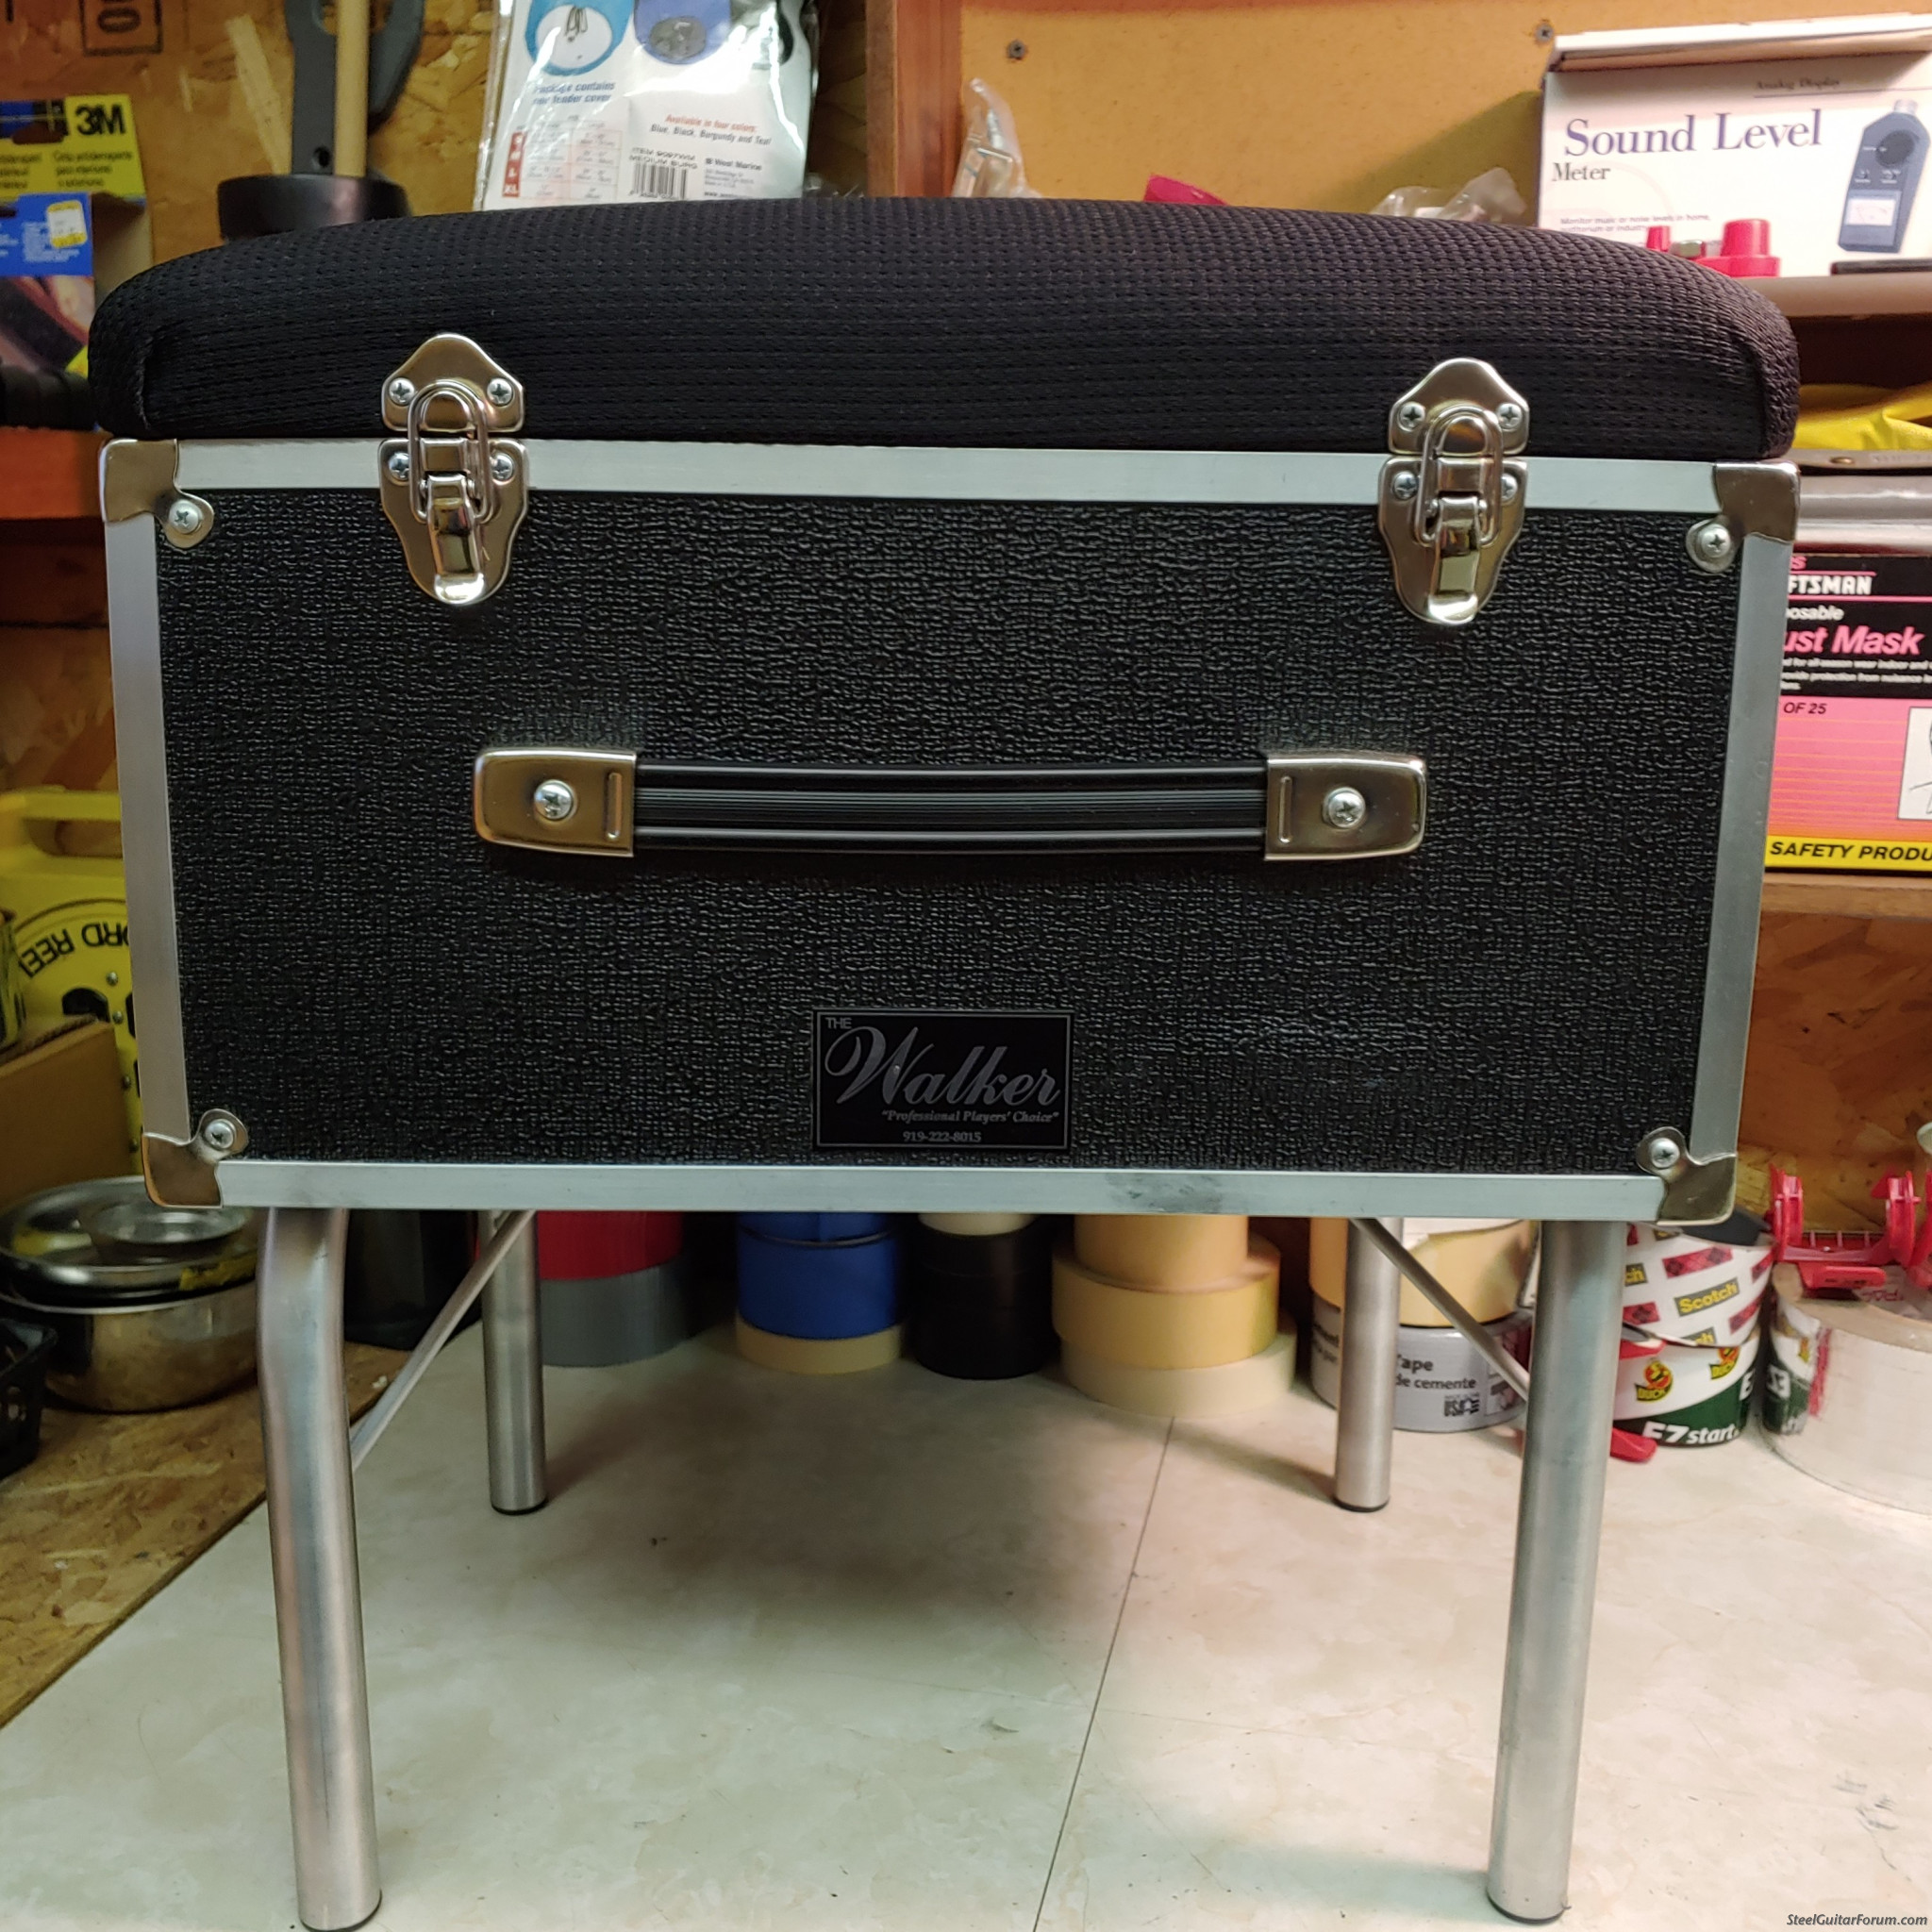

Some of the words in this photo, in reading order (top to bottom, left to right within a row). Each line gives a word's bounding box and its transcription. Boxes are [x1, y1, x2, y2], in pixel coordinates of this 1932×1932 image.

[575, 81, 616, 92] contains
[75, 104, 126, 135] 3M
[700, 129, 737, 143] Burgundy
[738, 135, 752, 143] and
[1564, 114, 1696, 157] Sound
[1711, 108, 1823, 151] Level
[1552, 160, 1611, 182] Meter
[1788, 575, 1873, 595] FTSMAN
[1831, 625, 1925, 655] Mask
[1783, 702, 1807, 714] OF
[1808, 703, 1827, 714] 25
[1770, 841, 1855, 858] SAFETY
[1858, 845, 1932, 861] PRODU
[825, 1017, 852, 1029] THE
[824, 1026, 1061, 1107] Walker
[1678, 1282, 1739, 1313] Scotch
[1413, 1377, 1477, 1390] cemente
